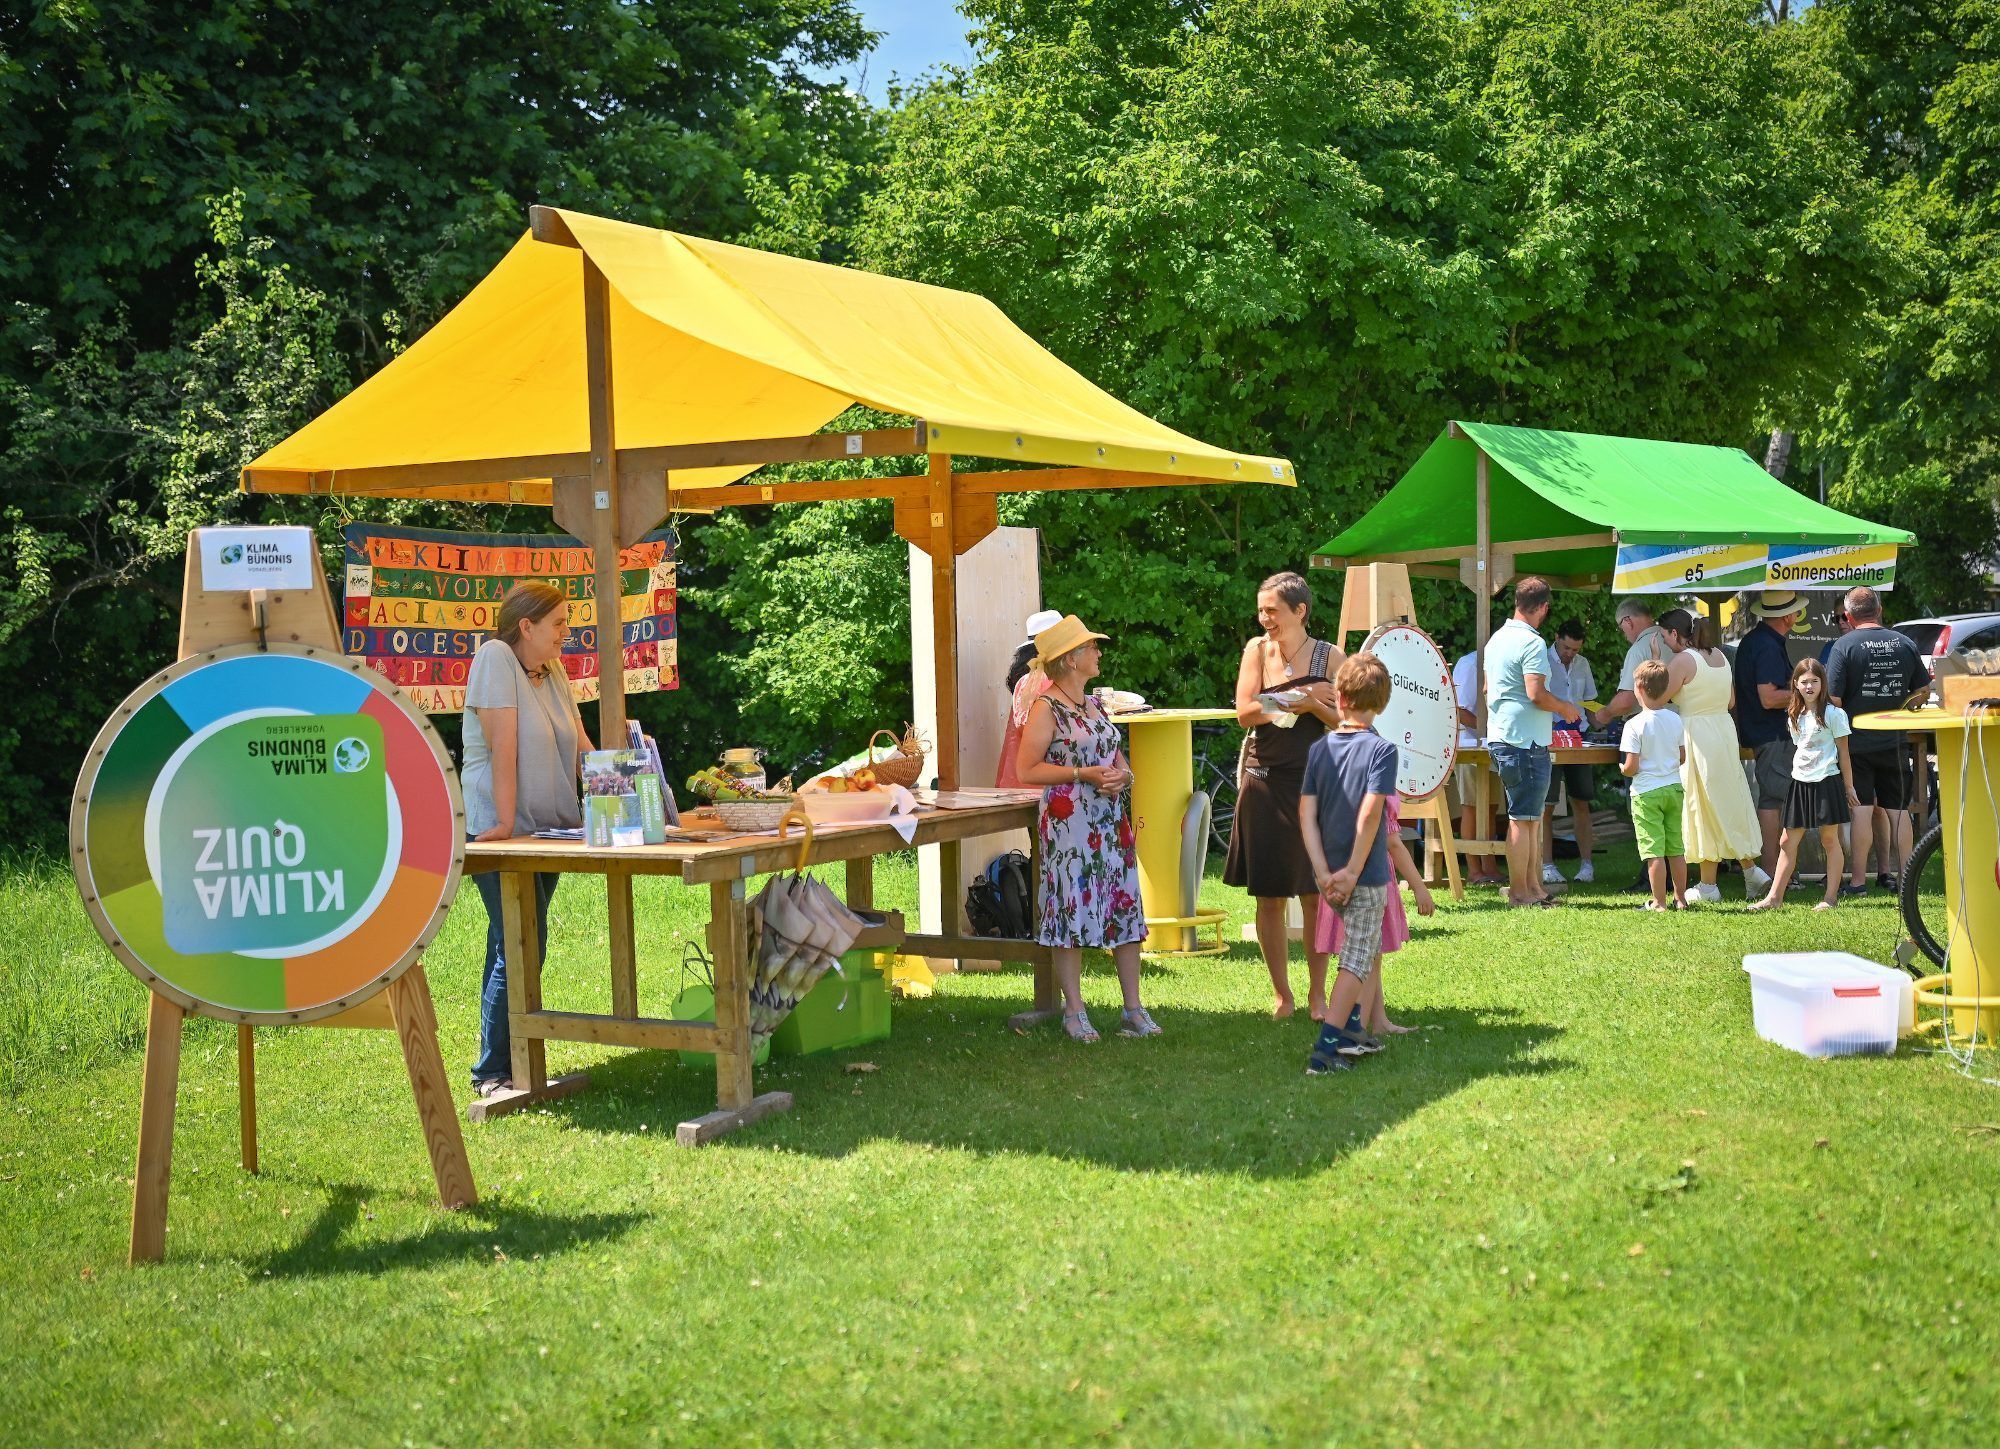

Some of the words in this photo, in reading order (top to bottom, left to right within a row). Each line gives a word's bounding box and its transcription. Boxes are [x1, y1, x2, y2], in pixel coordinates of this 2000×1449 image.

[246, 543, 279, 554] KLIMA
[247, 554, 293, 565] BÜNDNIS
[1685, 563, 1704, 582] e5
[1770, 561, 1885, 582] Sonnenscheine
[373, 601, 447, 626] ACIA
[1389, 673, 1440, 702] -Glücksrad
[265, 725, 325, 735] VORARLBERG
[247, 739, 327, 759] BÜNDNIS
[271, 758, 328, 776] KLIMA
[192, 818, 306, 873] QUIZ
[193, 869, 345, 920] KLIMA
